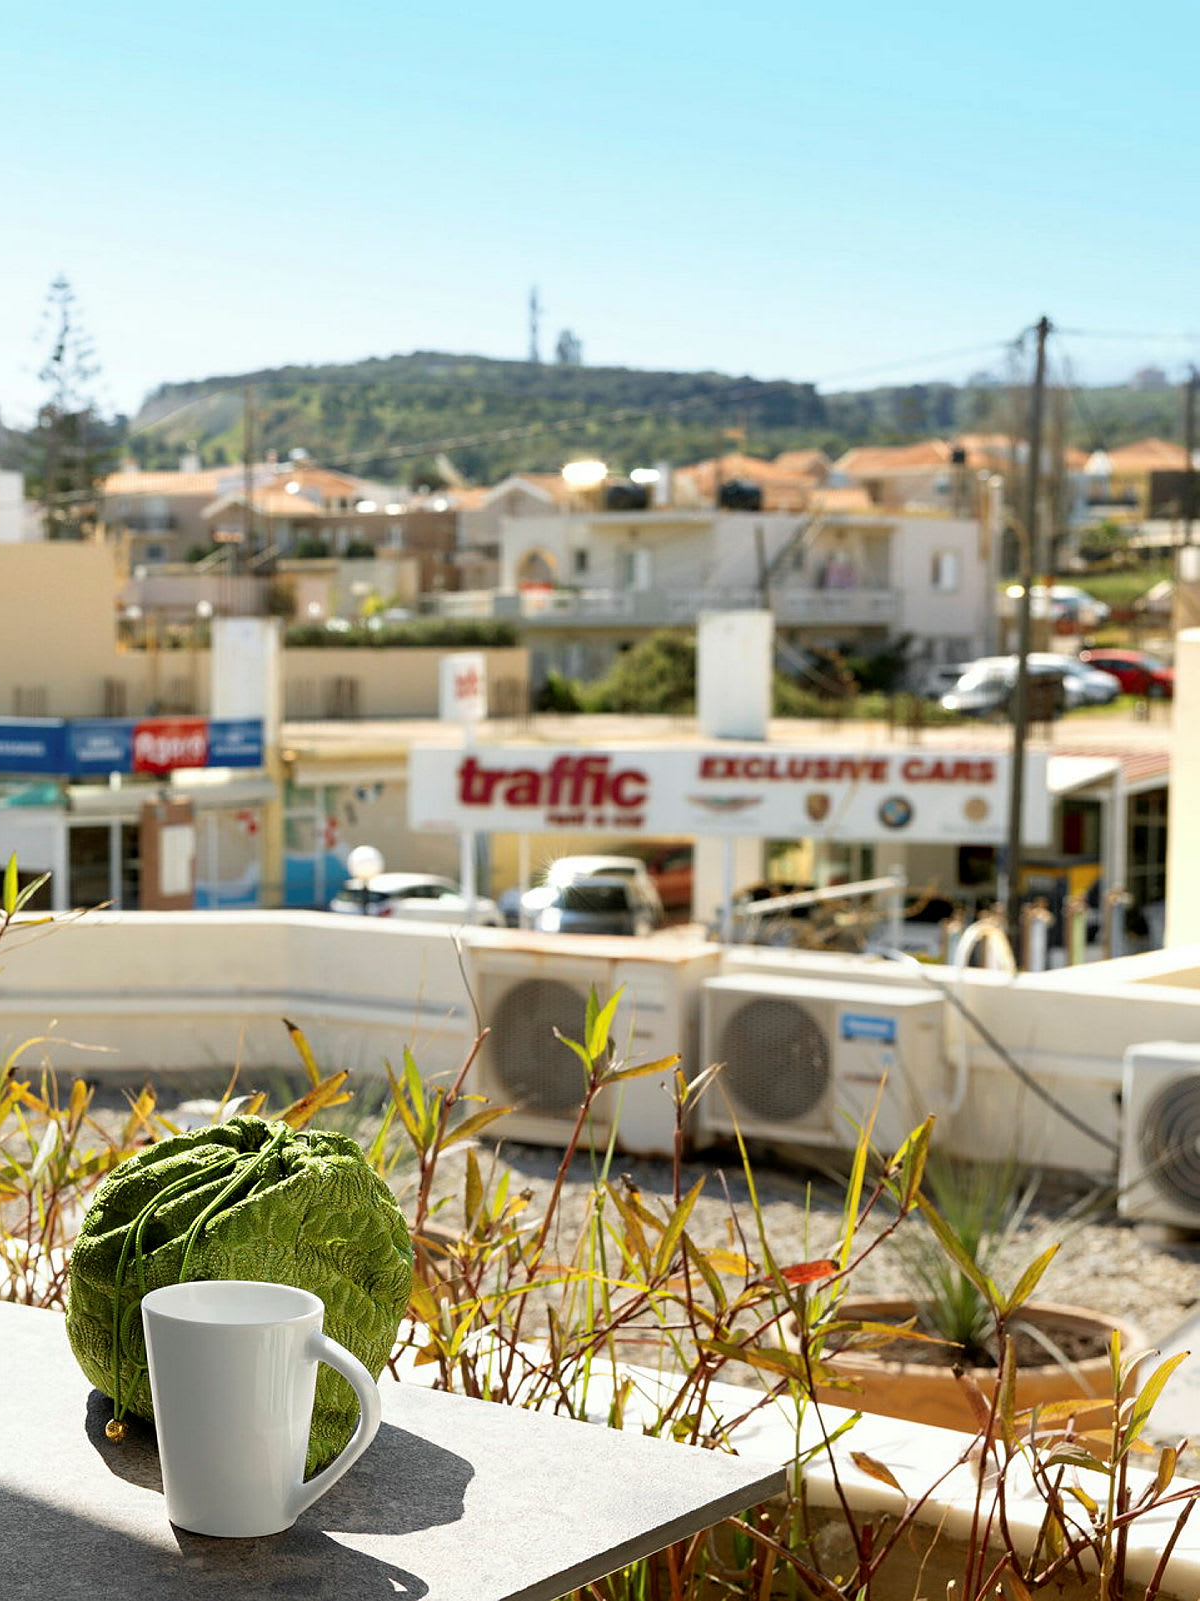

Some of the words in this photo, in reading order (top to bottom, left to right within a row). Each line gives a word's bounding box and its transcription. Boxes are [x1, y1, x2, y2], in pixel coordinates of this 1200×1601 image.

[458, 755, 650, 807] traffic
[699, 756, 889, 783] EXCLUSIVE
[900, 758, 998, 784] CARS
